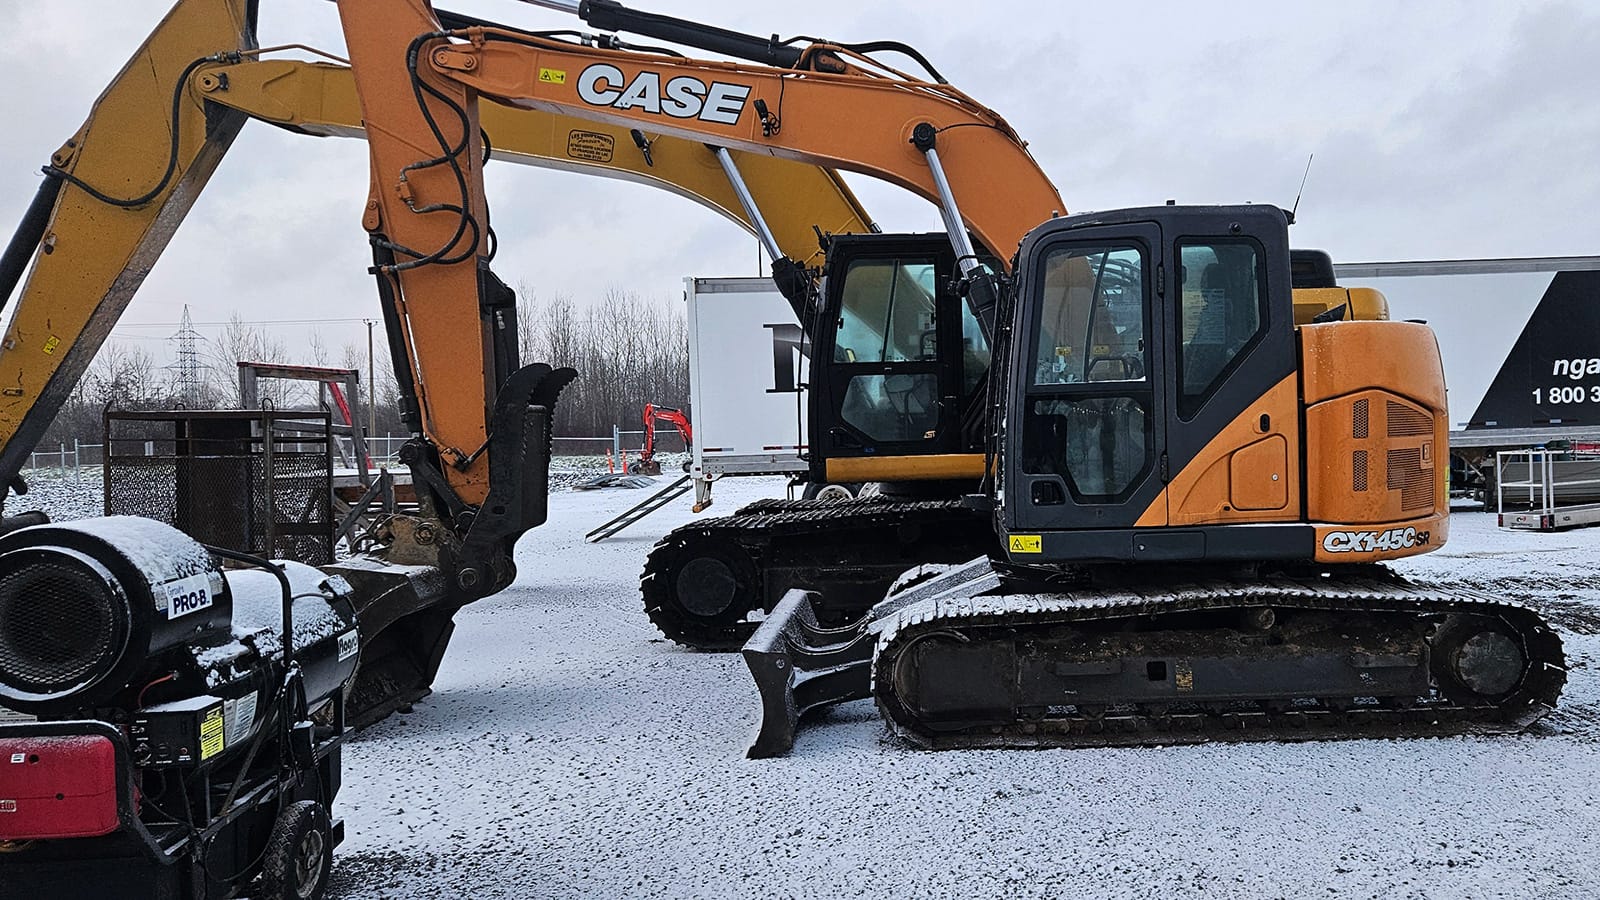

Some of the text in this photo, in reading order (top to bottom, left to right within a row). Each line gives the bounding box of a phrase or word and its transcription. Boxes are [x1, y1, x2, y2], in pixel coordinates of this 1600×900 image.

[577, 63, 752, 126] CASE
[1532, 387, 1541, 404] 1
[1549, 387, 1585, 404] 800
